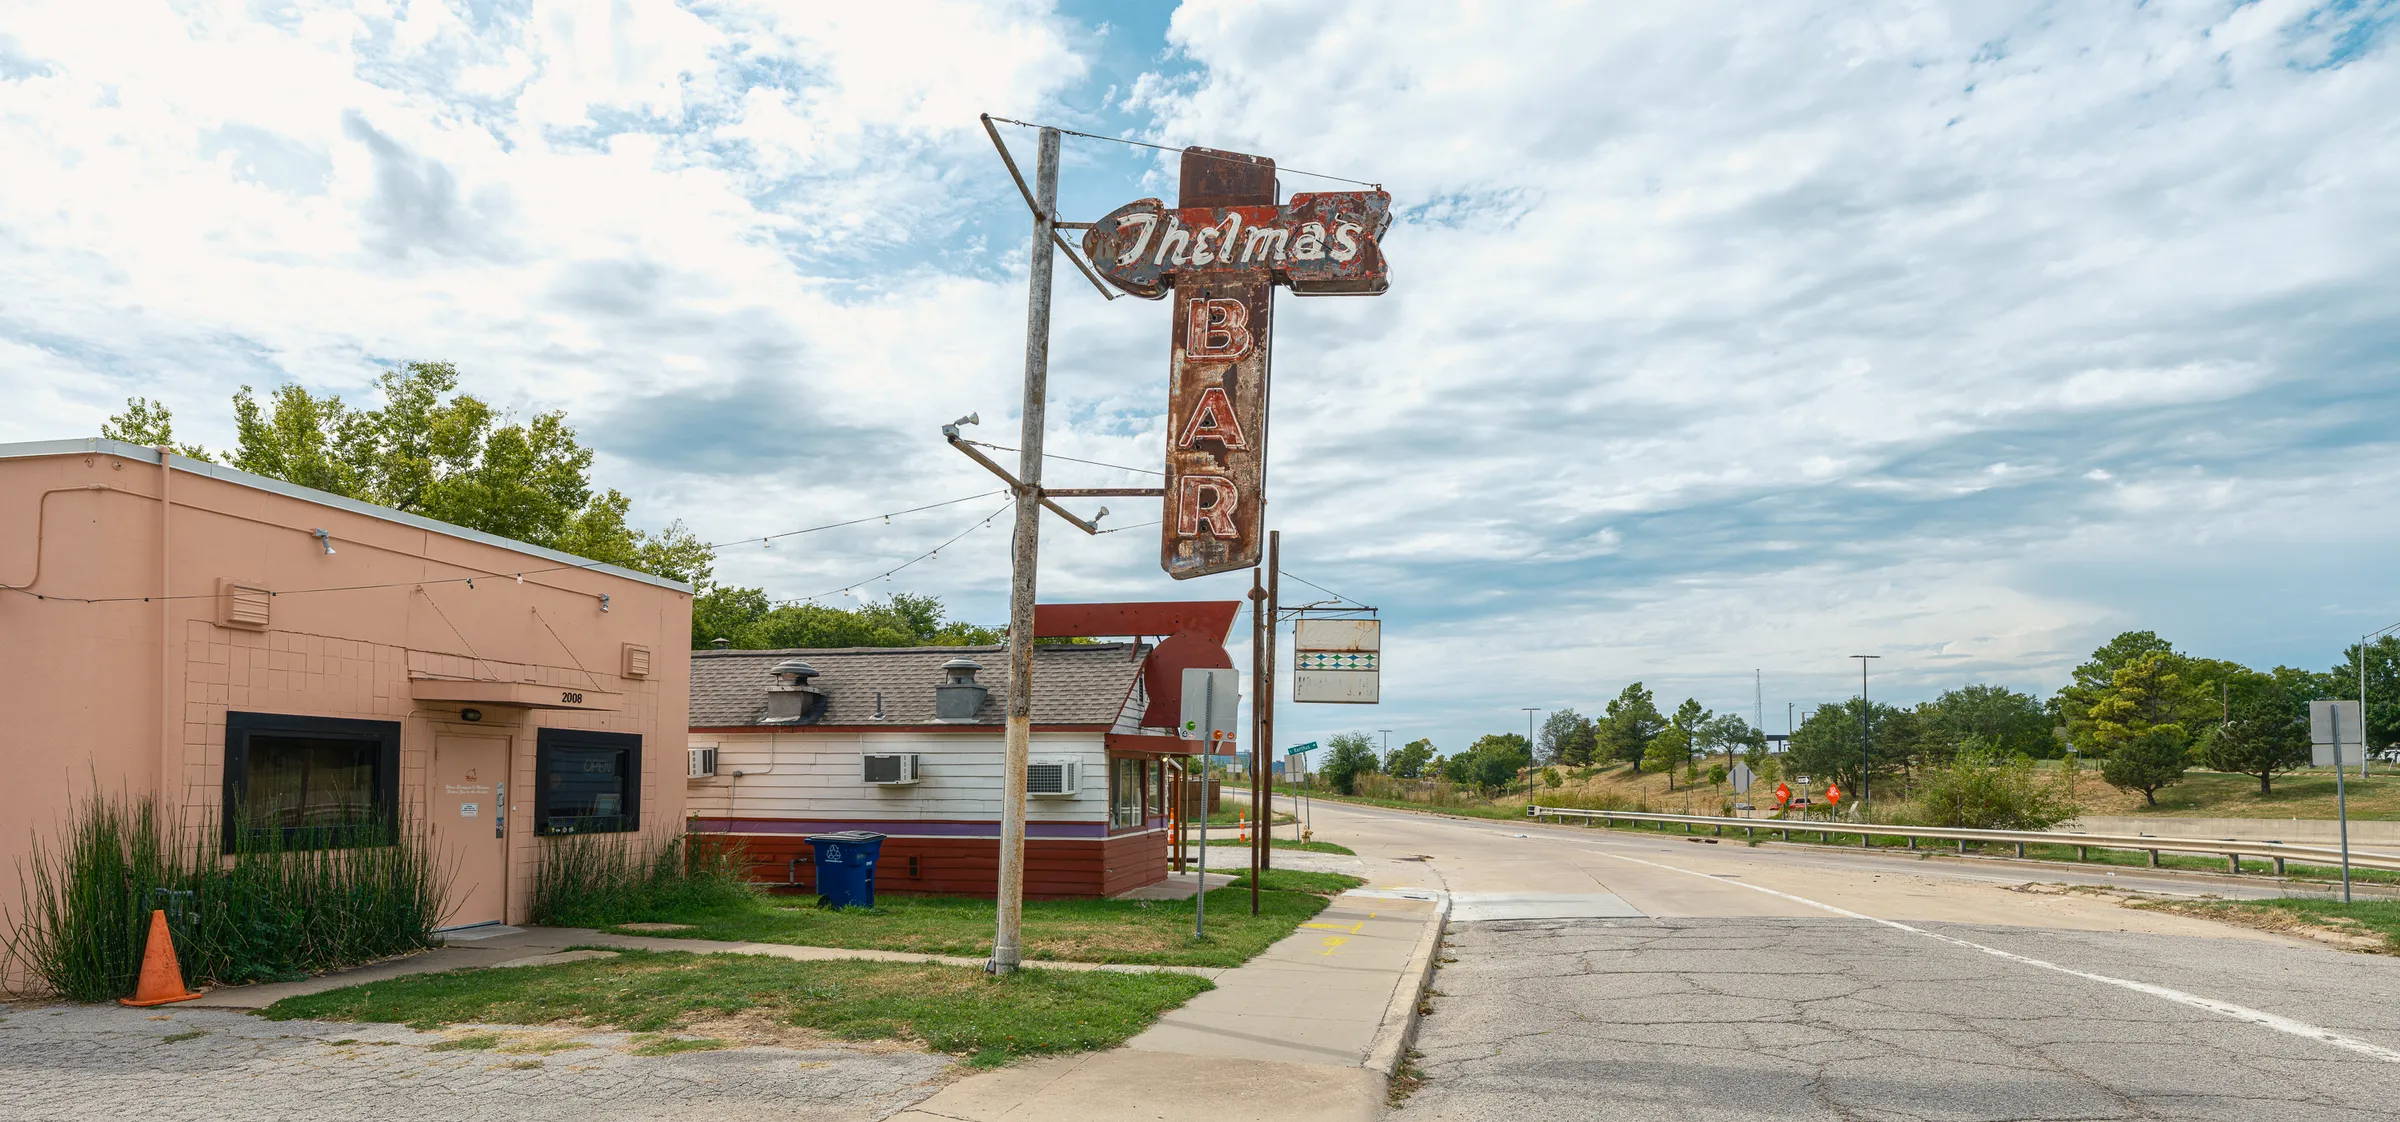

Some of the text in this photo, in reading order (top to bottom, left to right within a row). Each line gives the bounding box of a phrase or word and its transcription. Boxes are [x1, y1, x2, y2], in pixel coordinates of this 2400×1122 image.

[1116, 211, 1363, 266] Thelmas
[1178, 297, 1254, 538] BAR
[562, 692, 582, 703] 2008
[584, 759, 612, 773] OPEN
